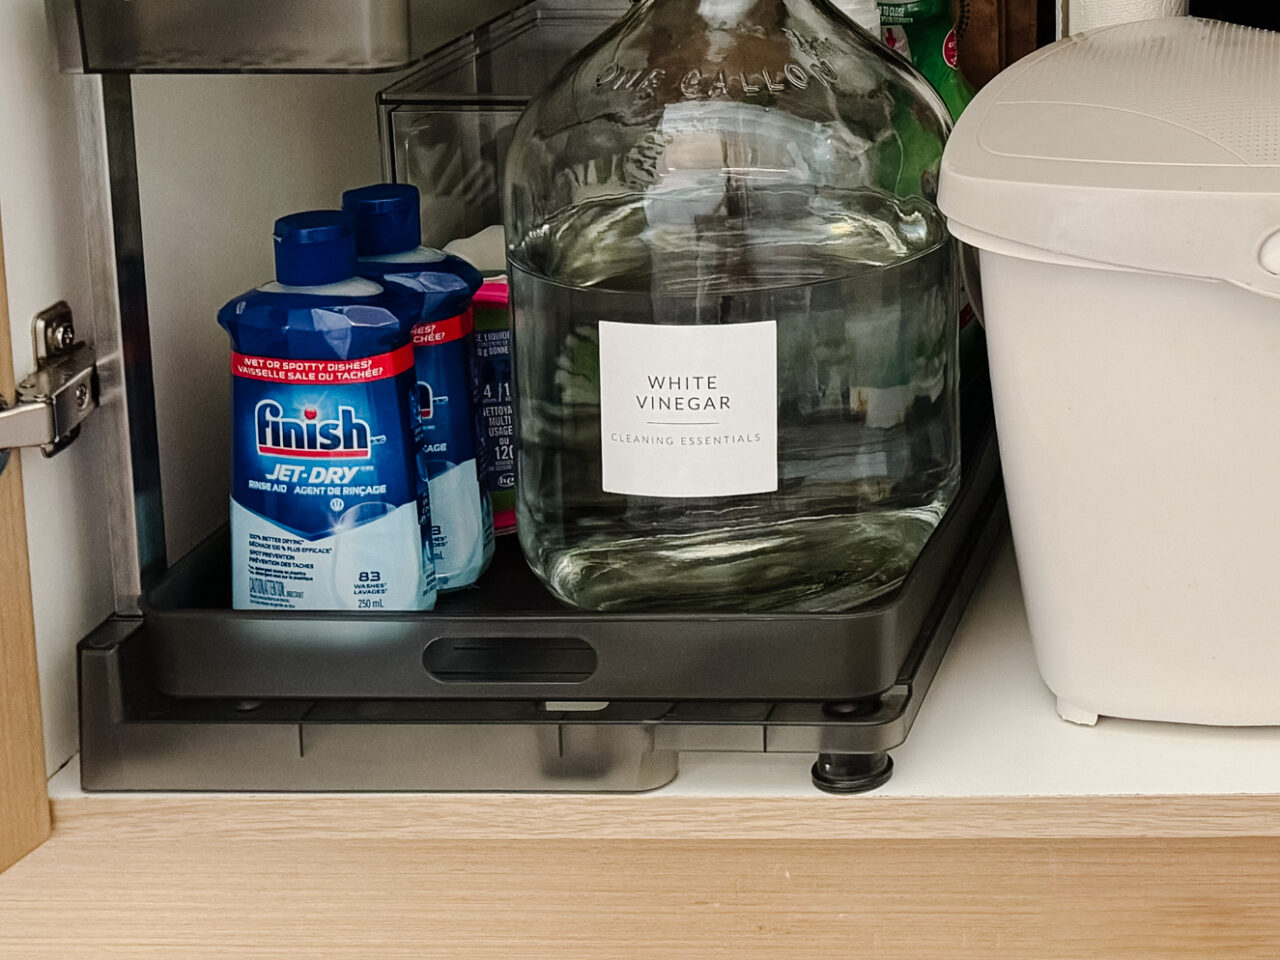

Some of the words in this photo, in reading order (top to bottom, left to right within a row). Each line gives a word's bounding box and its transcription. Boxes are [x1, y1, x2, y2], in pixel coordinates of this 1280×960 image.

[890, 7, 905, 18] CLOSE
[595, 63, 665, 96] ONE
[681, 58, 839, 99] GALLON
[244, 357, 264, 367] WET
[267, 360, 280, 369] OR
[282, 362, 325, 371] SPOTTY
[327, 360, 372, 372] DISHES?
[237, 365, 285, 379] VAISSELLE
[287, 371, 316, 381] SALE
[318, 371, 334, 380] OU
[336, 367, 384, 380] TACHÉE?
[648, 376, 717, 390] WHITE
[636, 396, 731, 411] VINEGAR
[255, 399, 371, 453] finish
[489, 416, 512, 426] MULTI
[488, 426, 513, 437] USAGE
[611, 433, 674, 446] CLEANING
[680, 433, 761, 446] ESSENTIALS
[265, 463, 360, 484] JET-DRY
[249, 480, 271, 491] RINSE
[272, 484, 287, 493] AID
[294, 486, 325, 496] AGENT
[327, 486, 340, 495] DE
[342, 485, 387, 497] RINÇAGE
[359, 571, 381, 582] 83
[358, 599, 371, 608] 250
[372, 599, 384, 608] mL
